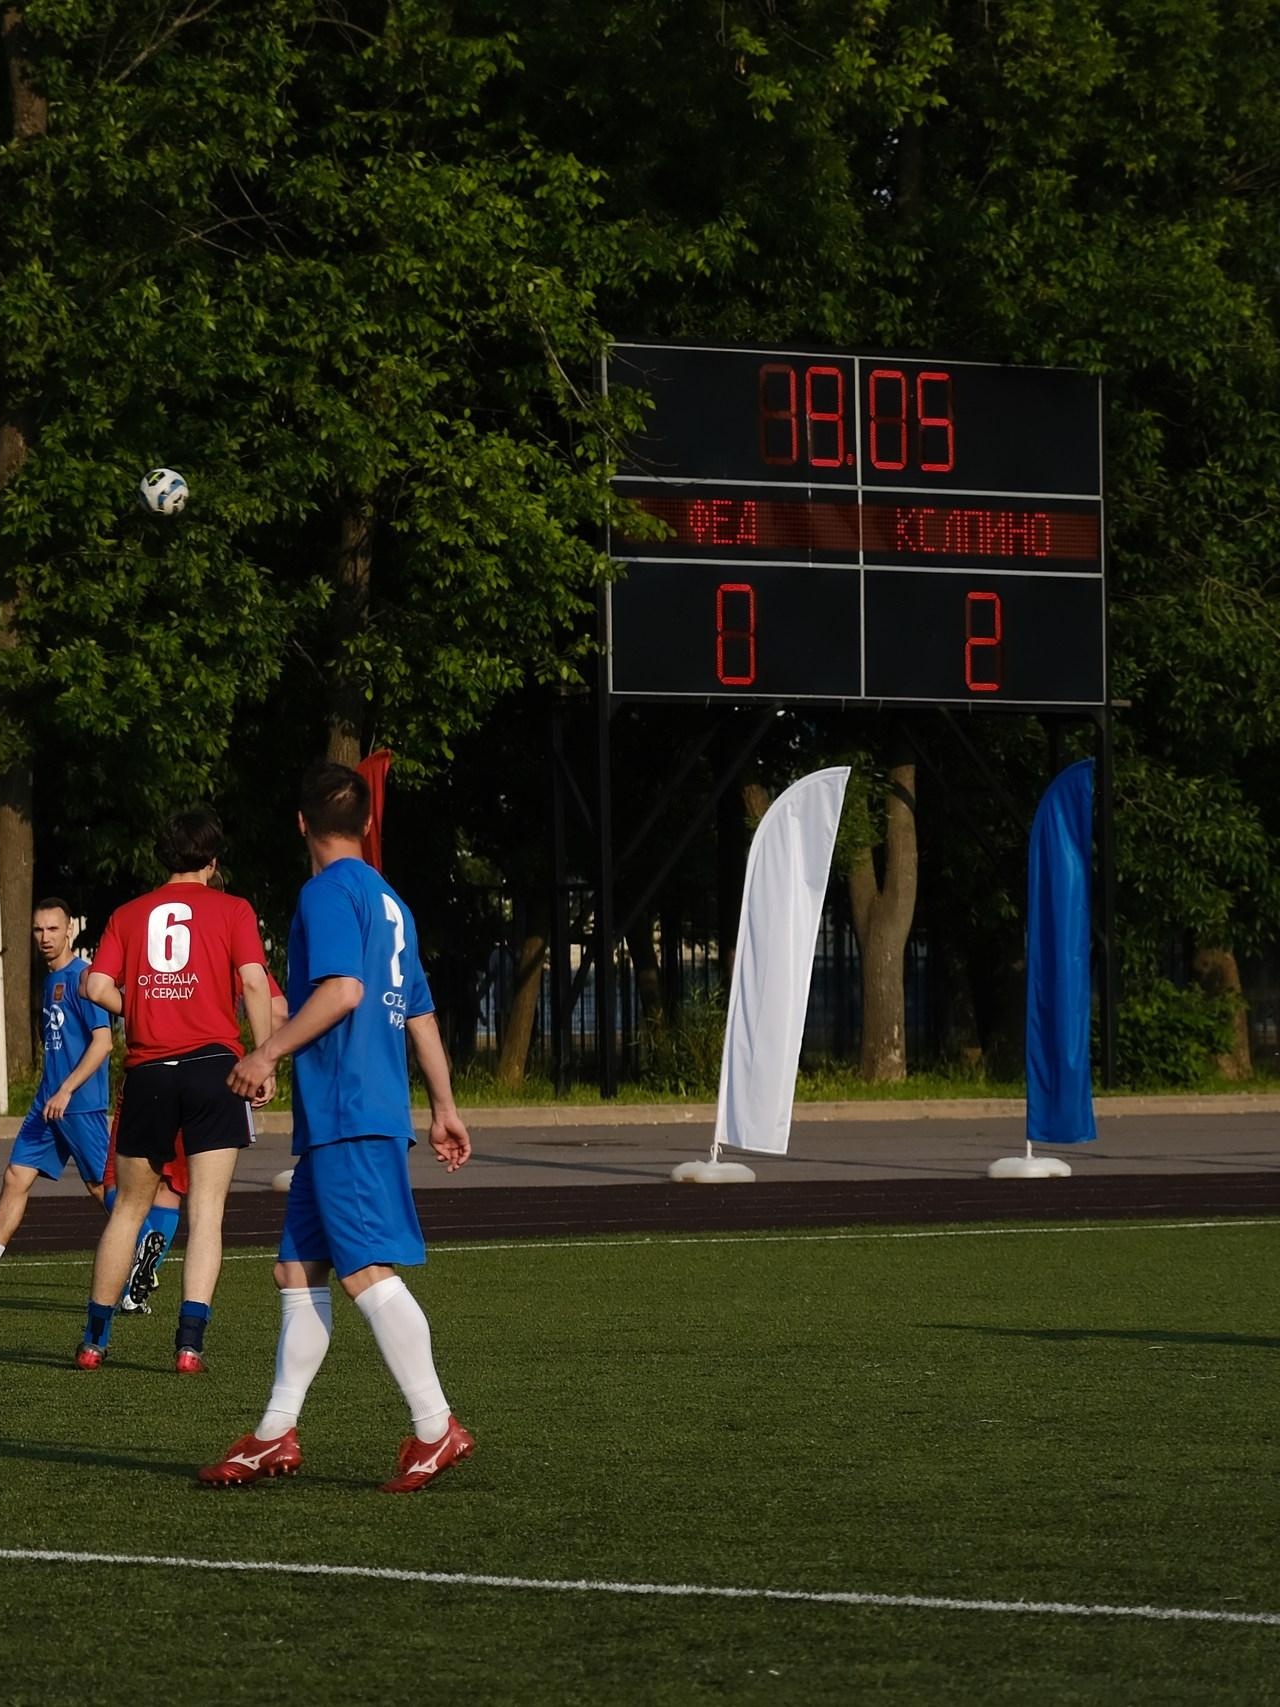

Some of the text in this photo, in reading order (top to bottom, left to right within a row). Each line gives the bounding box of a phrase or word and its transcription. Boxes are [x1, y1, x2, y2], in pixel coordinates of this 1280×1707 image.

[717, 583, 756, 685] 0
[965, 591, 1002, 692] 2
[147, 902, 193, 973] 6
[137, 972, 199, 986] ОТ СЕРДЦА
[151, 987, 195, 1001] СЕРДЦУ
